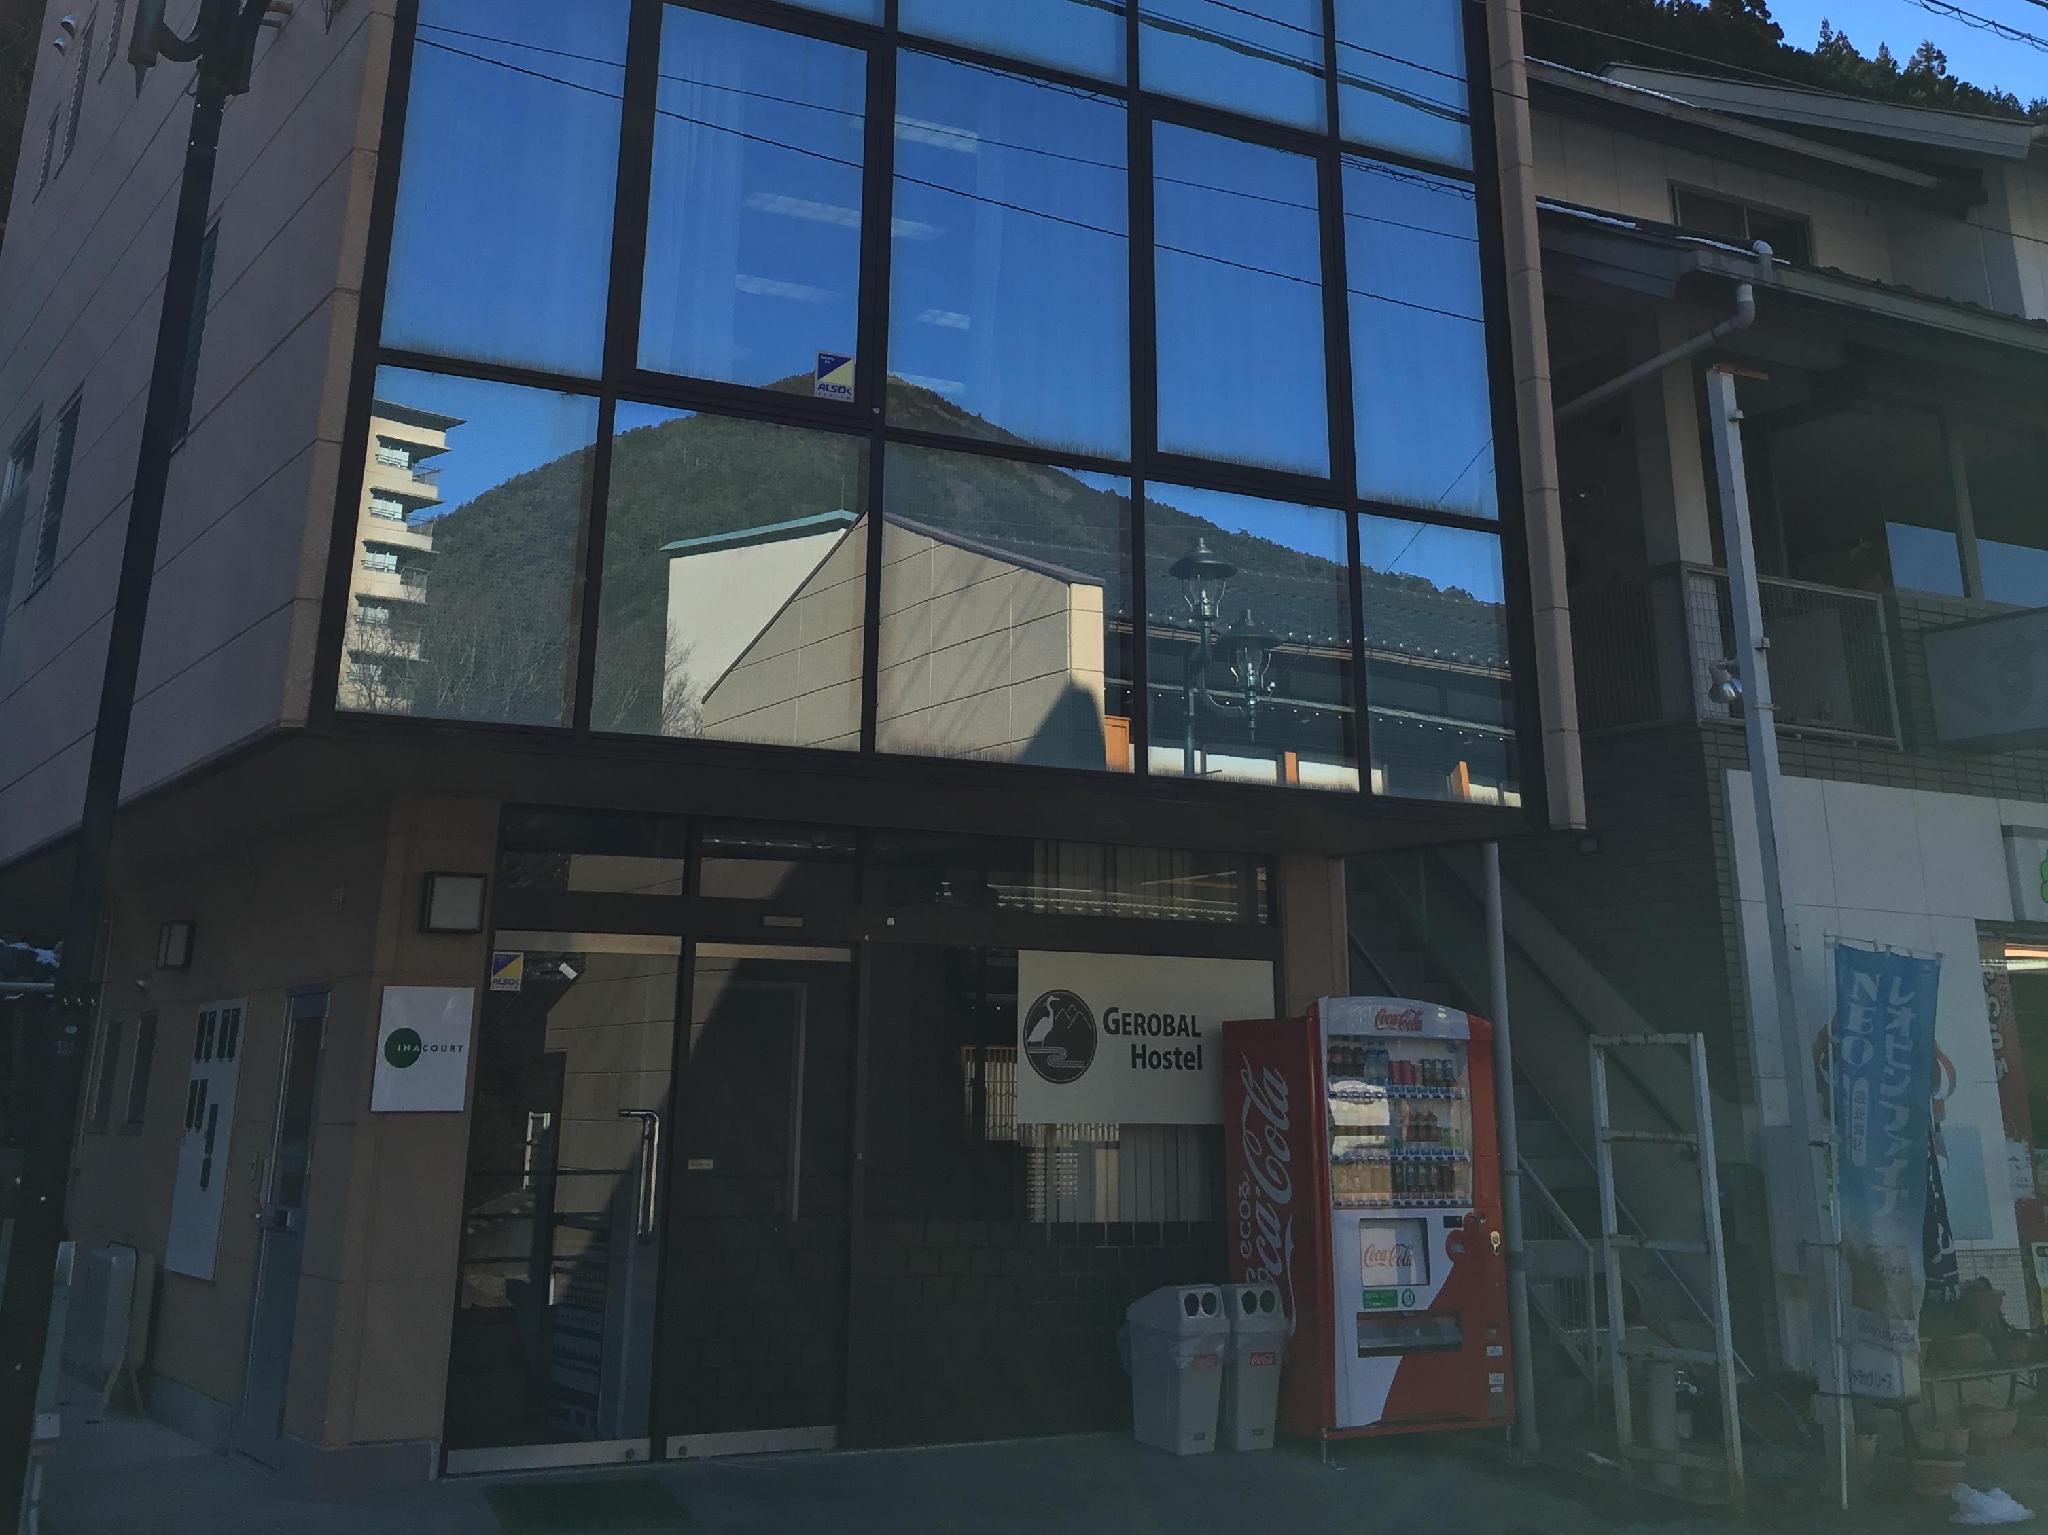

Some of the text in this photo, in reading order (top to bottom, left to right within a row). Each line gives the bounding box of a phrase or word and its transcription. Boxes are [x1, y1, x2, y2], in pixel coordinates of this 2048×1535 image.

[1102, 1006, 1202, 1038] GEROBAL
[1841, 971, 1881, 1067] NEO
[1131, 1043, 1203, 1071] Hostel
[1364, 1243, 1415, 1268] Coca-Cola
